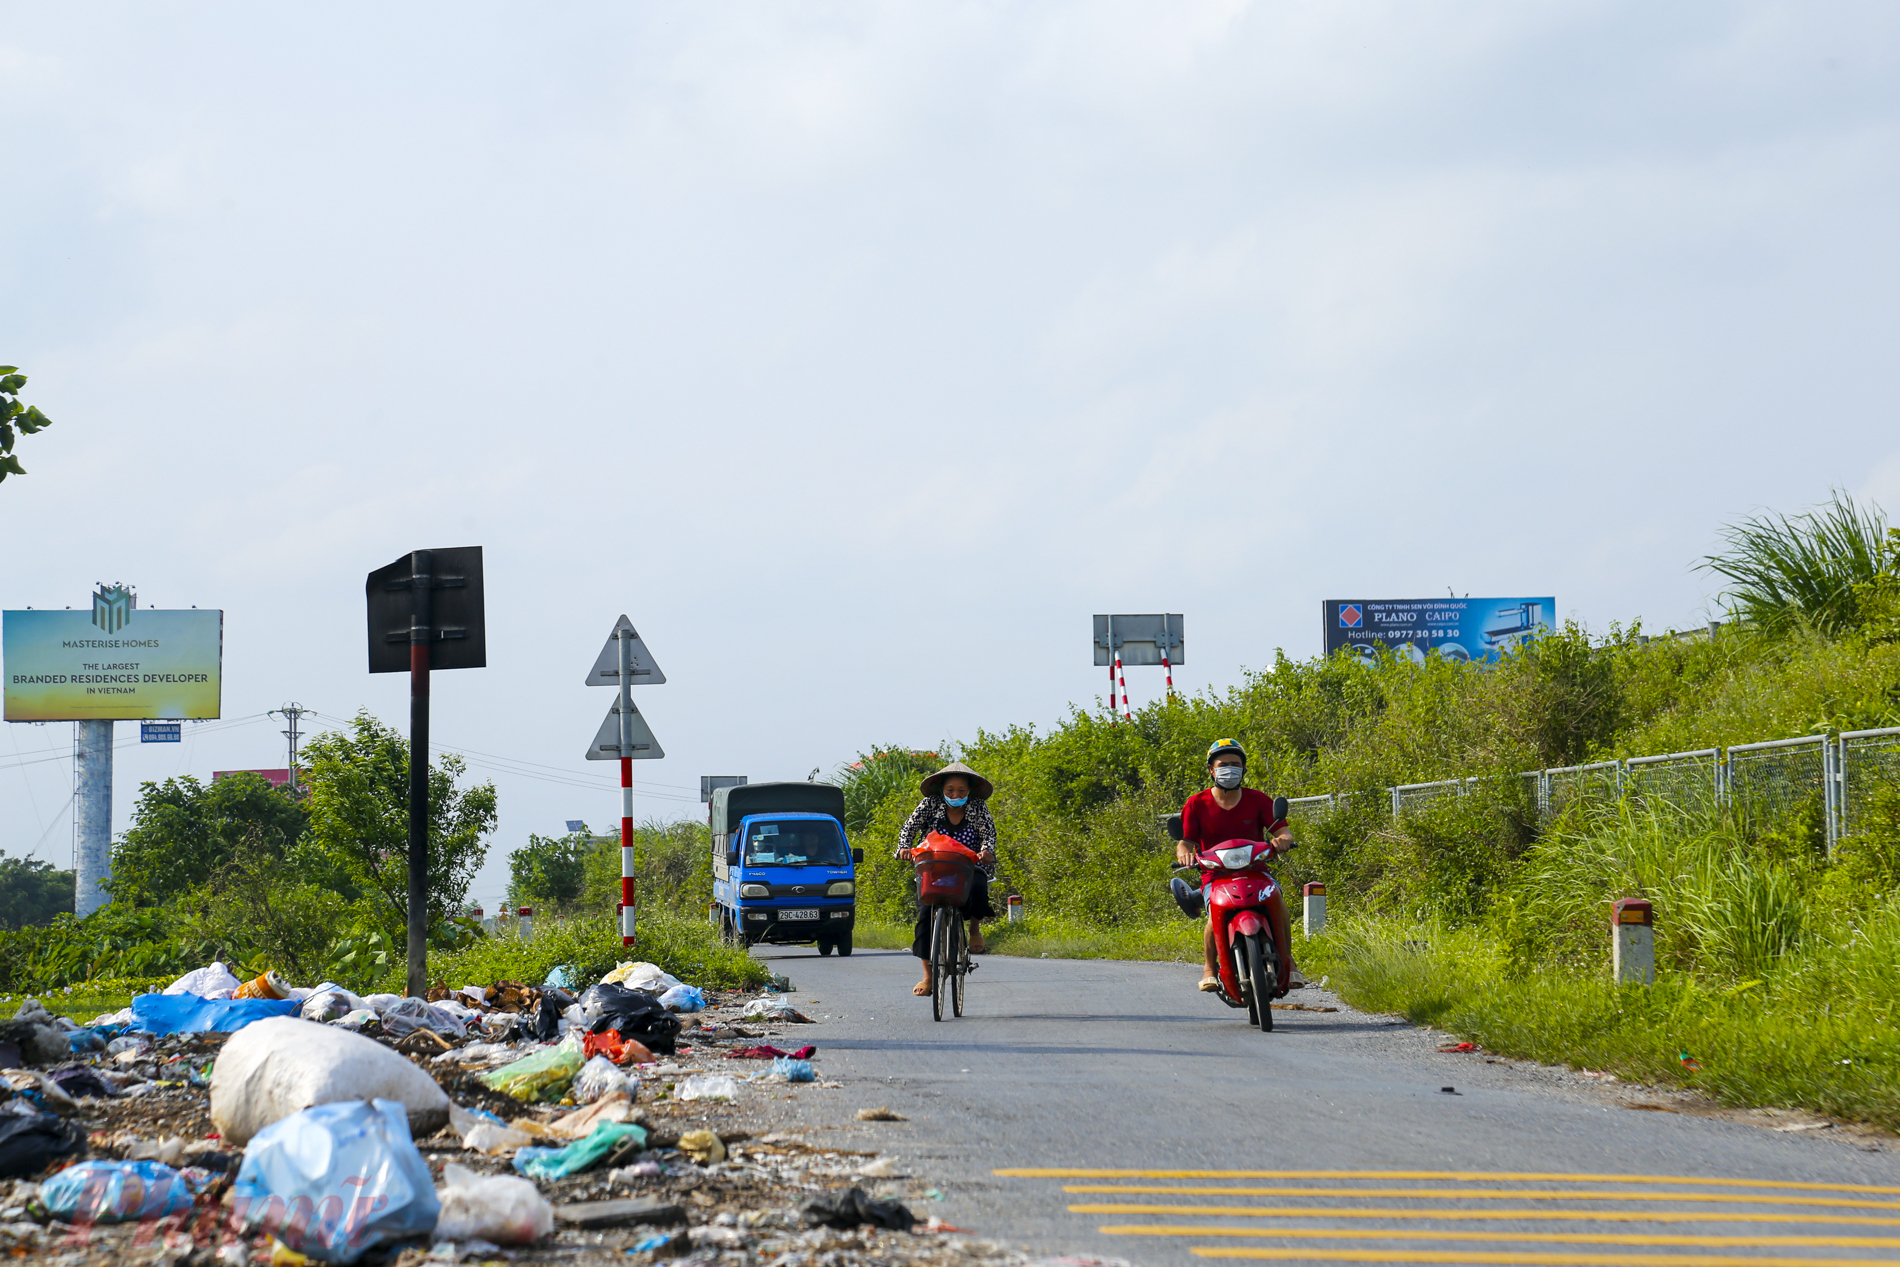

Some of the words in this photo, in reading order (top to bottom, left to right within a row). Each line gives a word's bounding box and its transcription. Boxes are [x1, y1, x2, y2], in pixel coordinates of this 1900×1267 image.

[1373, 612, 1417, 622] PLANO
[1425, 611, 1460, 621] CAIPO
[1348, 630, 1386, 639] Hotline:
[1388, 630, 1413, 639] 0977
[1416, 630, 1429, 638] 30
[1431, 630, 1444, 638] 58
[1446, 629, 1460, 638] 30
[62, 639, 120, 648] MASTERISE
[122, 639, 159, 648] HOMES
[13, 674, 67, 684] BRANDED
[70, 674, 140, 684] RESIDENCES
[143, 674, 208, 683] DEVELOPER
[86, 687, 96, 695] IN
[98, 687, 136, 695] VIETNAM
